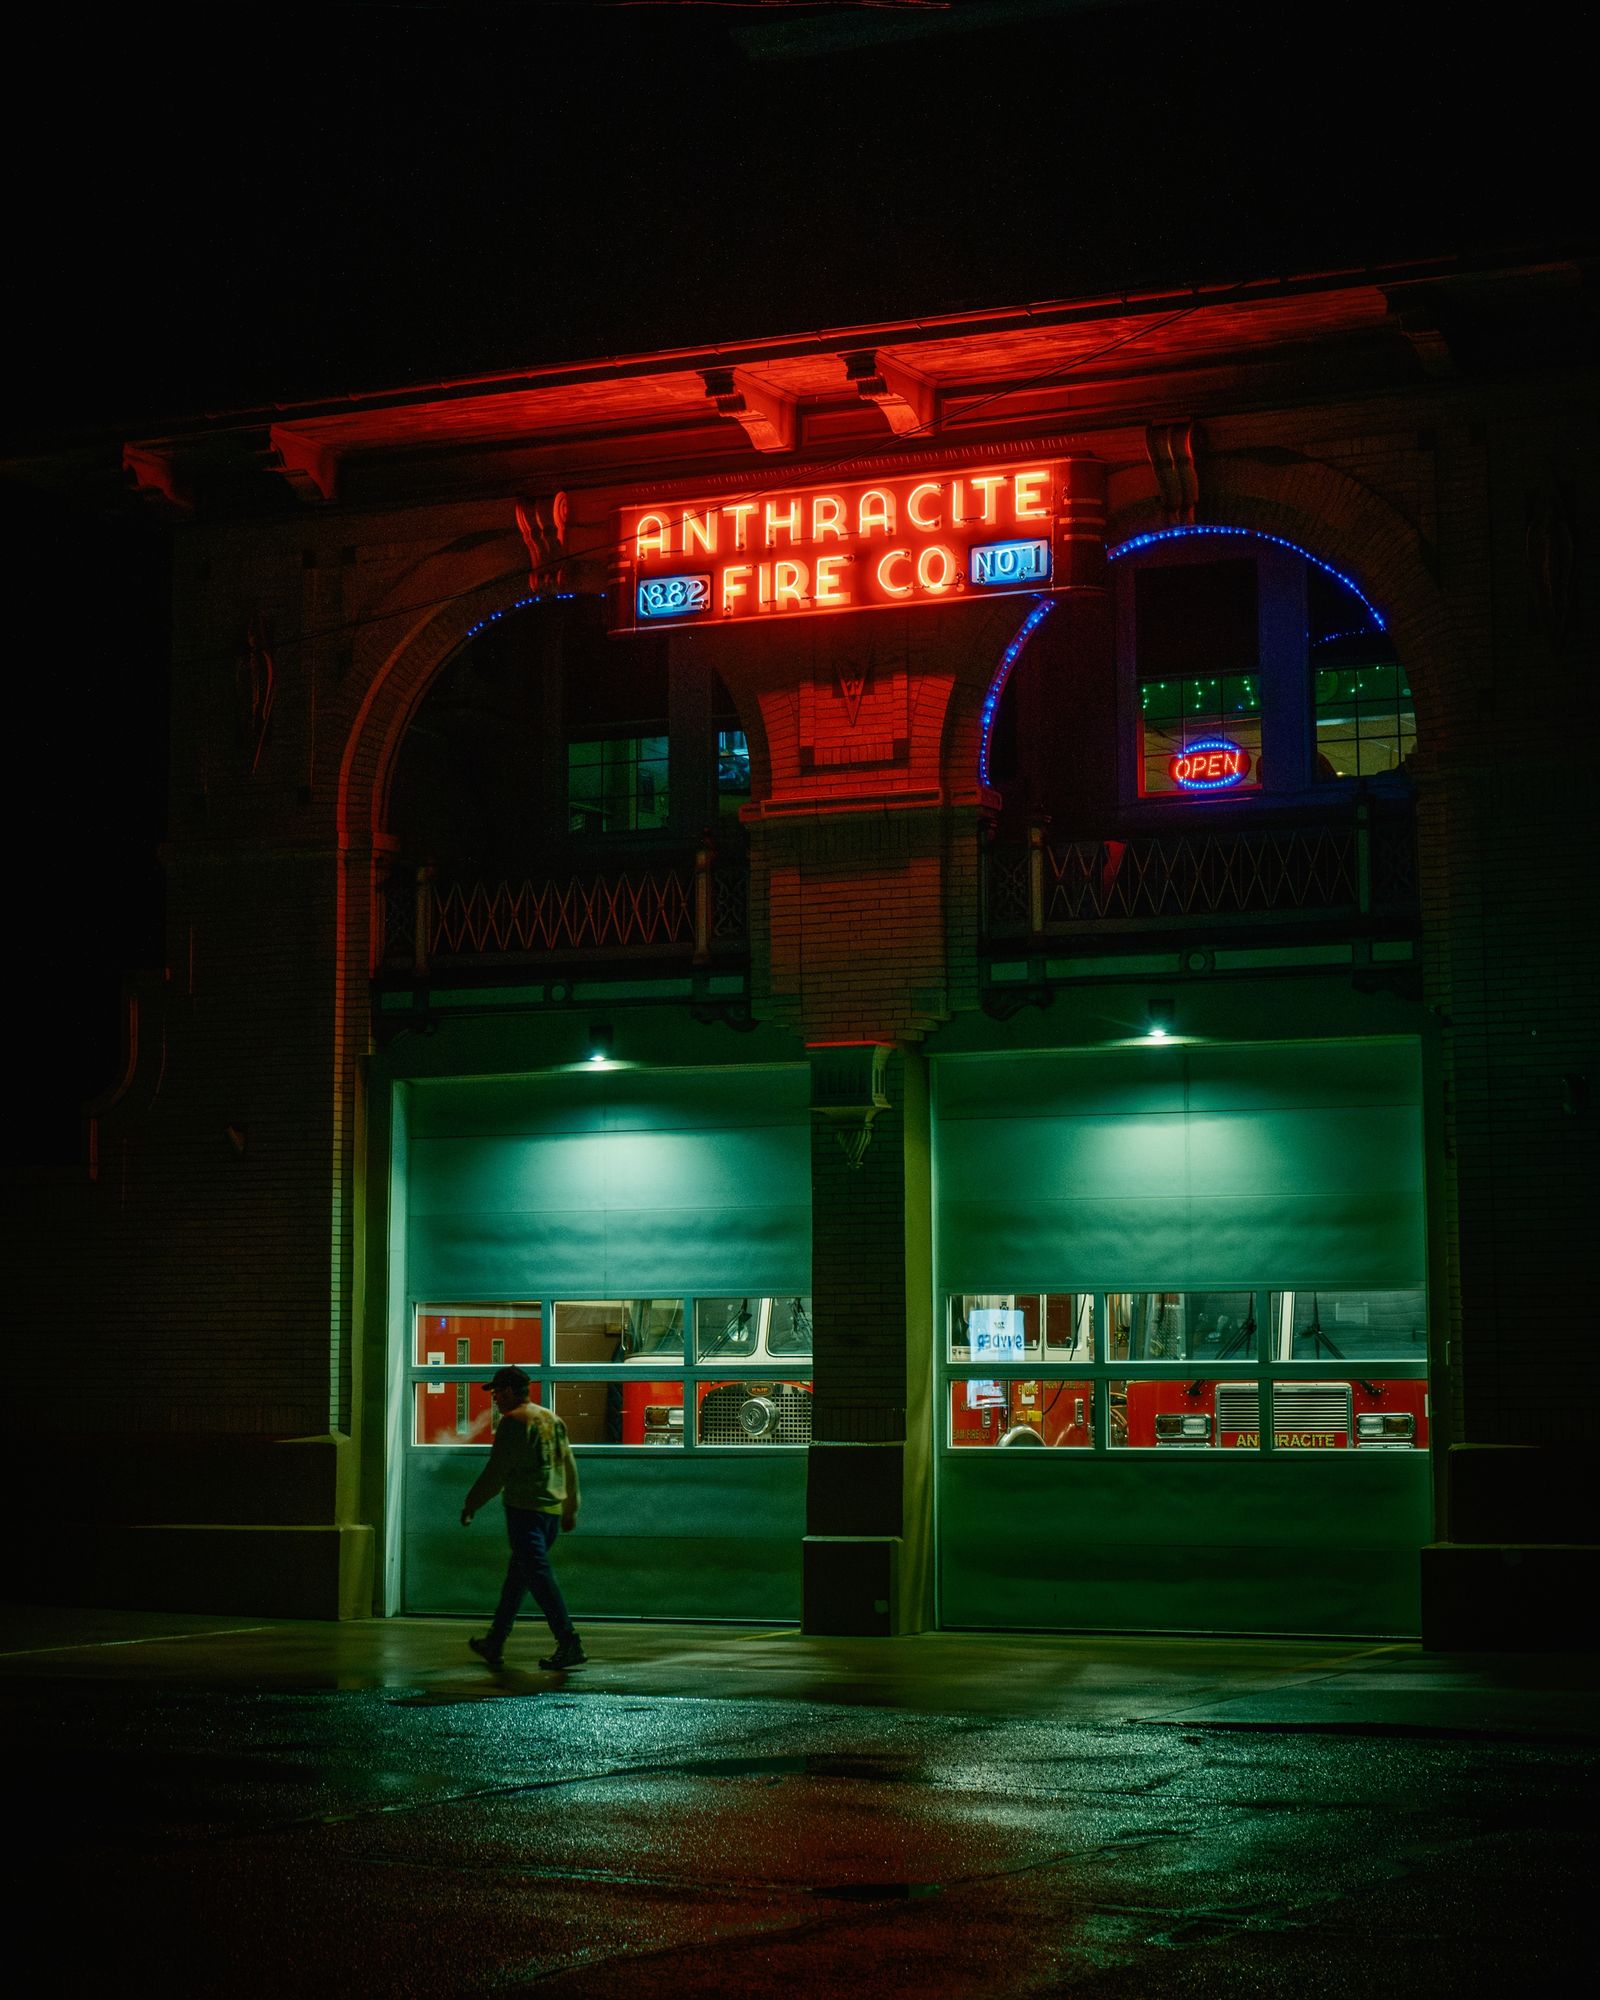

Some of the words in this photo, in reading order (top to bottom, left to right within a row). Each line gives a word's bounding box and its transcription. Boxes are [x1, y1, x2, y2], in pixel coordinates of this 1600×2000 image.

[636, 470, 1050, 560] ANTHRACITE
[640, 580, 708, 615] 1882
[722, 555, 854, 616] FIRE
[1175, 751, 1240, 779] OPEN
[1236, 1434, 1335, 1448] ANRACITE
